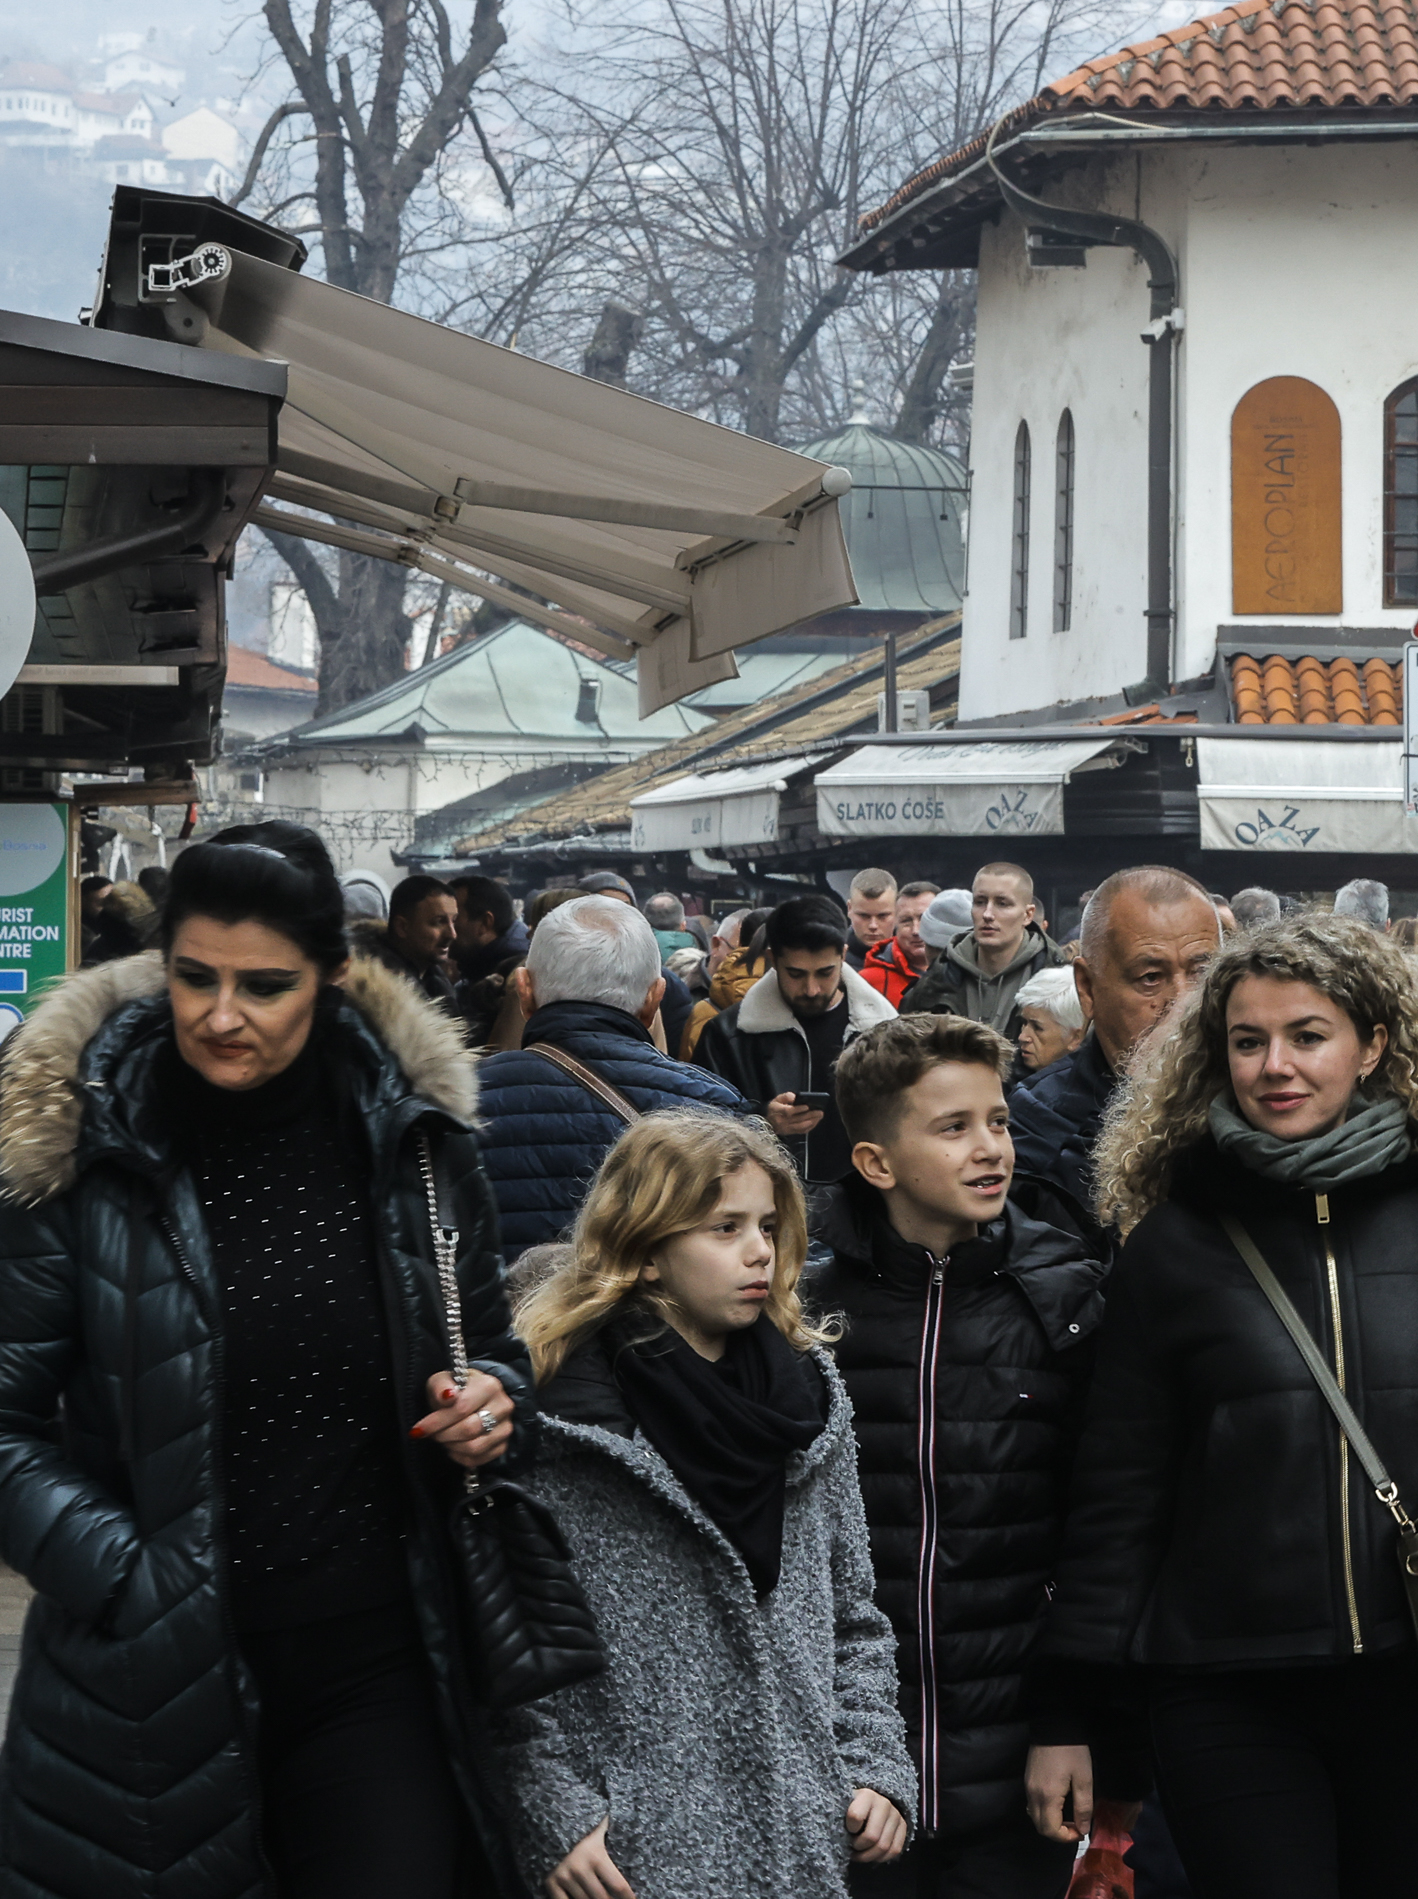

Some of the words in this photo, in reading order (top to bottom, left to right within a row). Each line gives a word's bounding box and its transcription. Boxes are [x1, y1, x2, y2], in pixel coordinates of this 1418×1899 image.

[1263, 433, 1296, 603] AEROPLAN
[836, 802, 897, 821] SLATKO
[902, 797, 944, 820] ĆOŠE
[985, 791, 1038, 831] OAZA
[1235, 805, 1320, 847] OAZA
[0, 907, 34, 923] RIST
